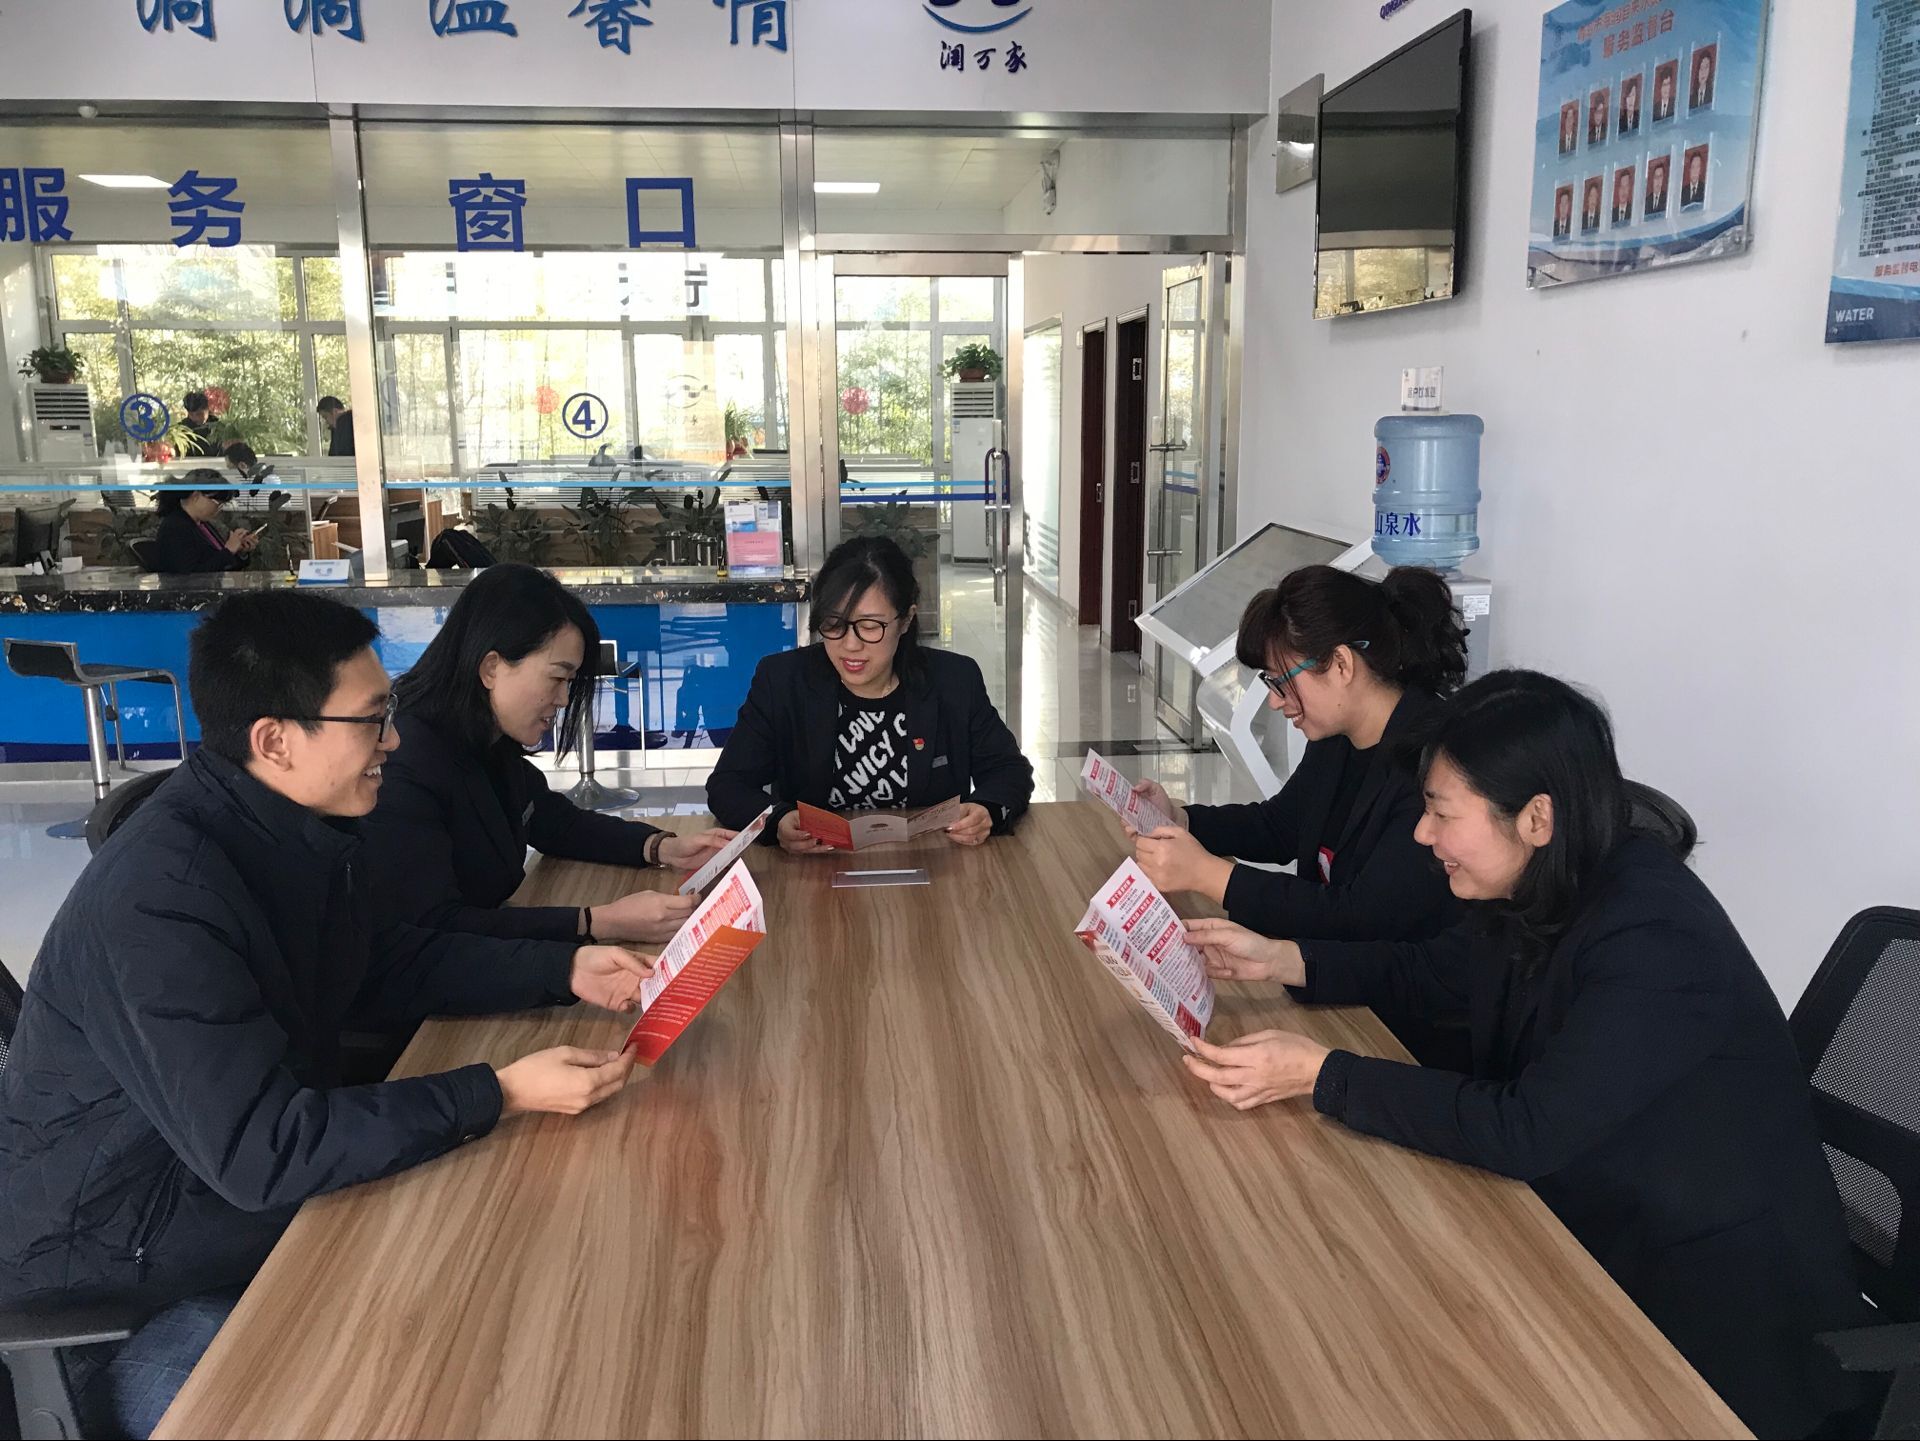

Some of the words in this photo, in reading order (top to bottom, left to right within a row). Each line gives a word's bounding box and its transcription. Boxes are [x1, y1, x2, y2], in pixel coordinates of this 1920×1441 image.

[940, 40, 1028, 74] 润万家
[0, 167, 696, 253] 服务窗口
[1835, 307, 1875, 322] WATER
[1375, 511, 1421, 536] 山泉水
